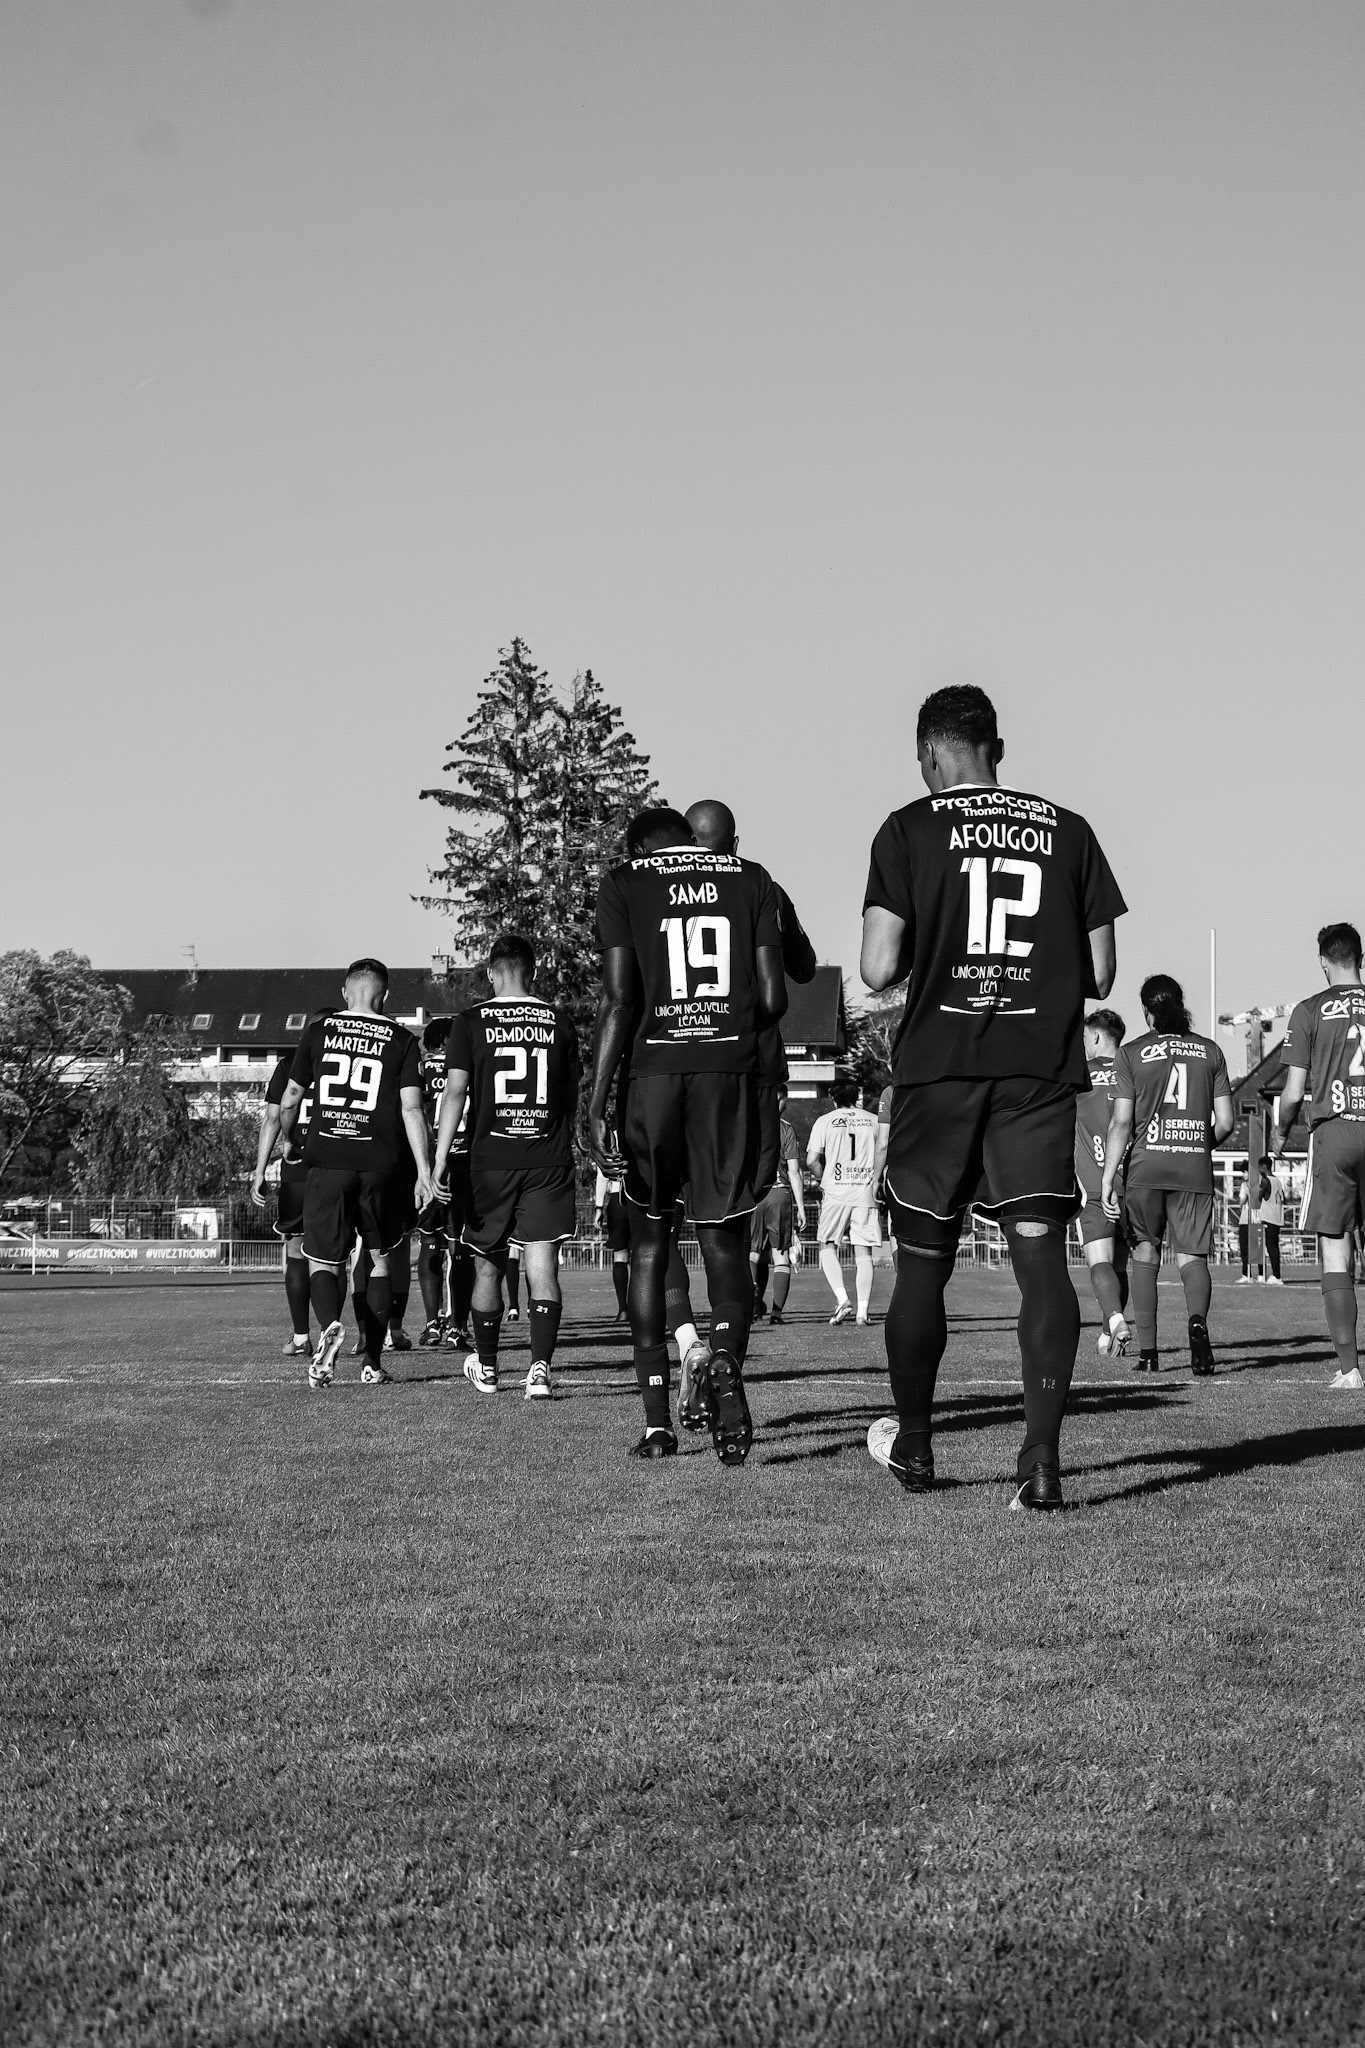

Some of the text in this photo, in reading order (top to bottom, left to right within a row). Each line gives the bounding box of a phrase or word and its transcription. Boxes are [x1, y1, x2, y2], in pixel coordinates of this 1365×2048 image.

[931, 792, 1057, 817] Promocash
[961, 807, 1058, 827] Thonon Les Bains
[949, 823, 1052, 856] AFOUGOU
[631, 854, 742, 870] Promocash
[656, 863, 742, 875] Thonon Les Bains
[669, 882, 718, 905] SAMB
[960, 857, 1043, 958] 12
[659, 915, 731, 1000] 19
[952, 964, 986, 979] UNION
[480, 1006, 555, 1020] Promocash
[655, 1002, 730, 1018] UNION NOUVELLE
[324, 1018, 393, 1036] Promocash
[497, 1016, 524, 1024] Thonon
[337, 1026, 392, 1041] Thonon Les Bains
[485, 1026, 555, 1045] DEMDOUM
[324, 1035, 385, 1056] MARTELAT
[1169, 1040, 1206, 1051] CENTRE
[1170, 1049, 1207, 1059] FRANCE
[320, 1053, 383, 1111] 29
[494, 1047, 548, 1104] 21
[1165, 1119, 1205, 1130] SERENYS
[1164, 1131, 1205, 1142] GROUPE
[848, 1133, 856, 1160] 1
